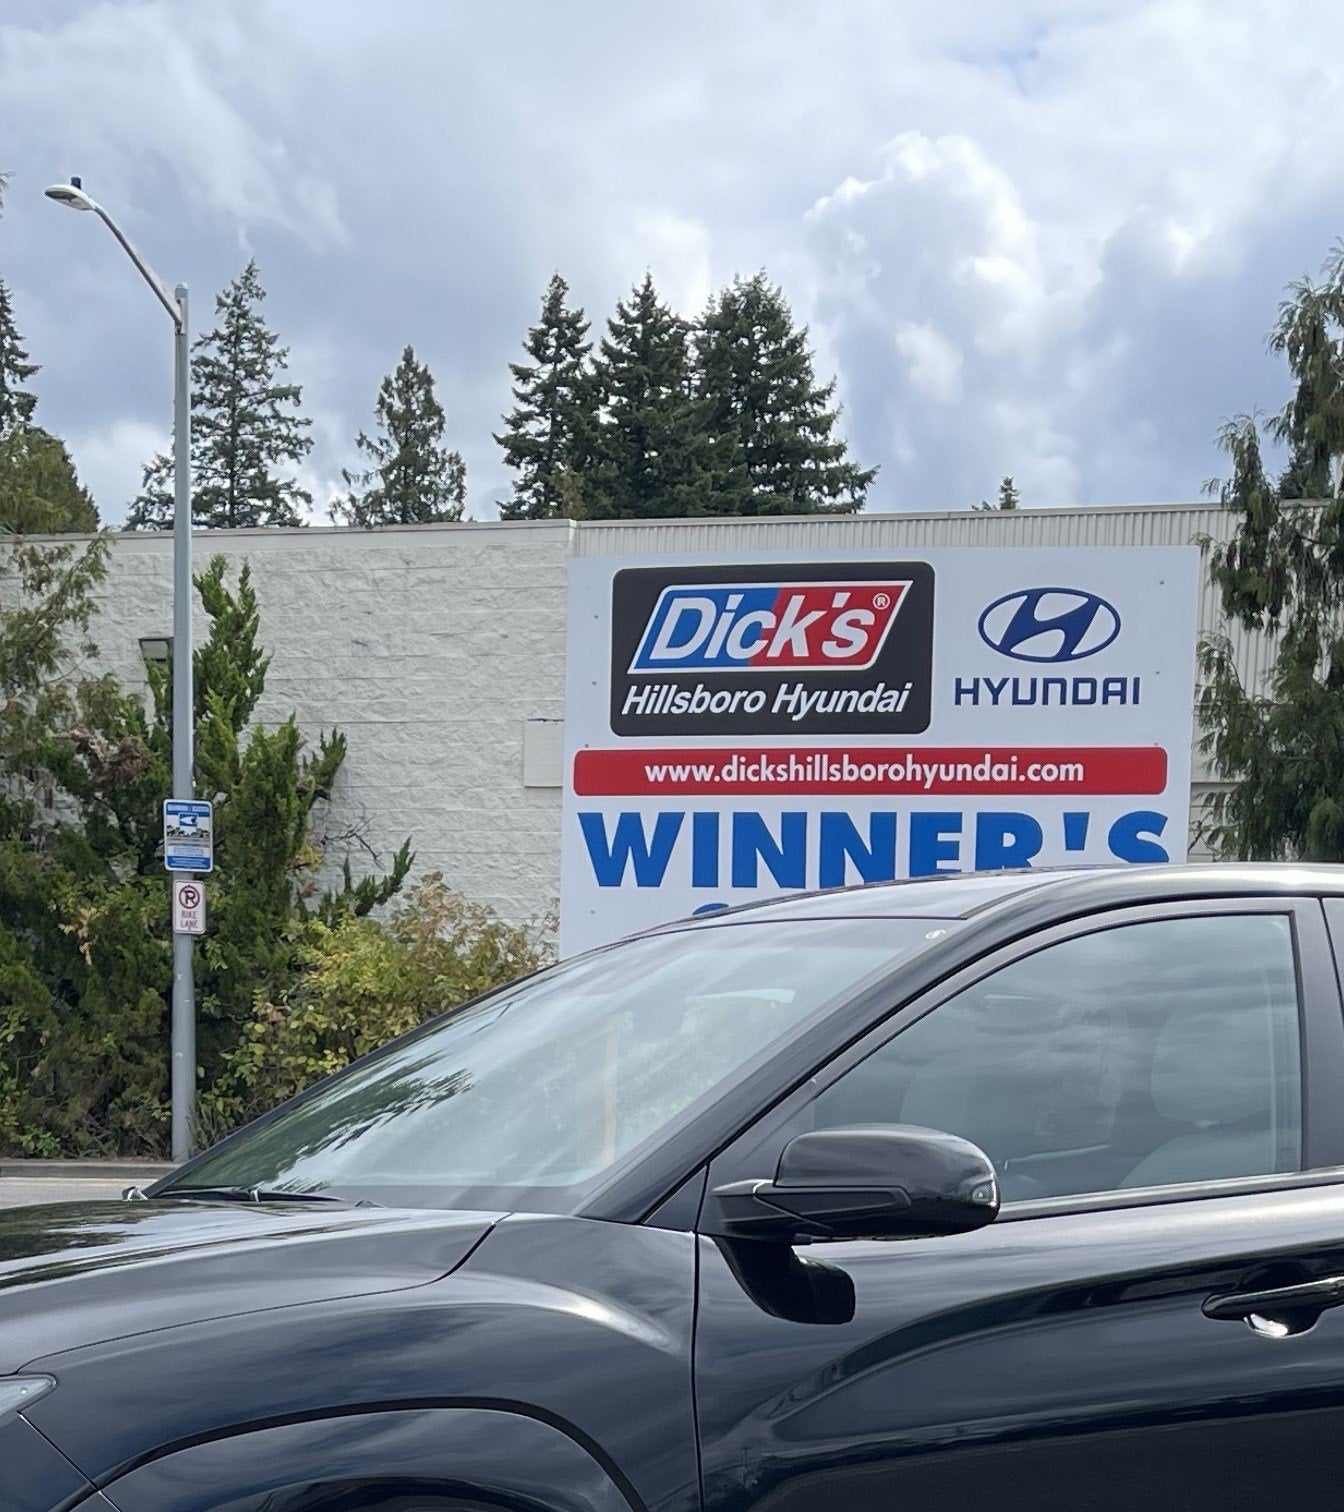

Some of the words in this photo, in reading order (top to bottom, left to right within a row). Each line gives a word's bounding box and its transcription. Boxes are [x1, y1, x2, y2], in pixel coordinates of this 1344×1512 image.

[649, 592, 875, 660] Dick's
[621, 684, 767, 715] Hillsboro
[770, 682, 913, 721] Hyundai
[953, 676, 1141, 706] HYUNDAI
[644, 754, 1085, 790] www.dickshillsborohyundai.com
[577, 810, 1170, 889] WINNER'S
